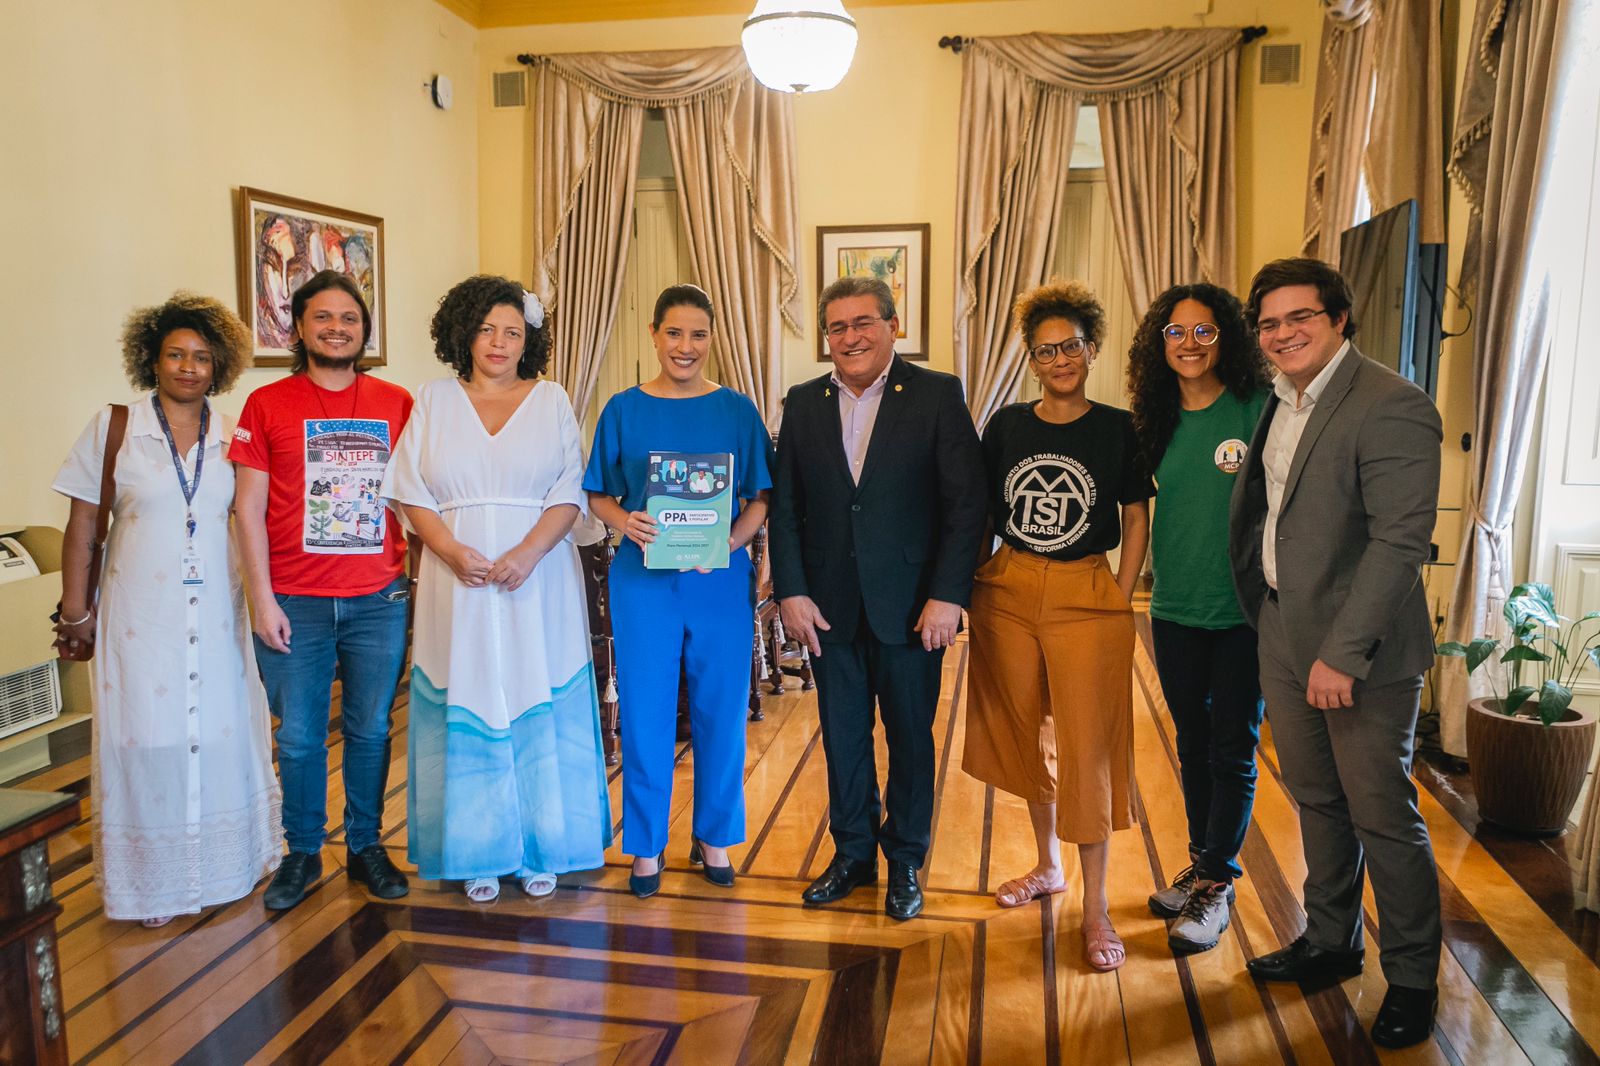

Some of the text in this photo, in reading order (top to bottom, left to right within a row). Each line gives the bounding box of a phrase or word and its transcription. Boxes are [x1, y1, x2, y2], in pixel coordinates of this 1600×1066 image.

[325, 450, 375, 462] SINTEPE
[1003, 465, 1020, 503] MOVIMENTO
[1018, 456, 1033, 468] DOS
[1033, 453, 1088, 475] TRABALHADORES
[1084, 473, 1096, 488] SEM
[664, 512, 687, 522] PPA
[1021, 524, 1064, 536] BRASIL
[1033, 542, 1068, 553] REFORMA
[1066, 522, 1091, 546] URBANA
